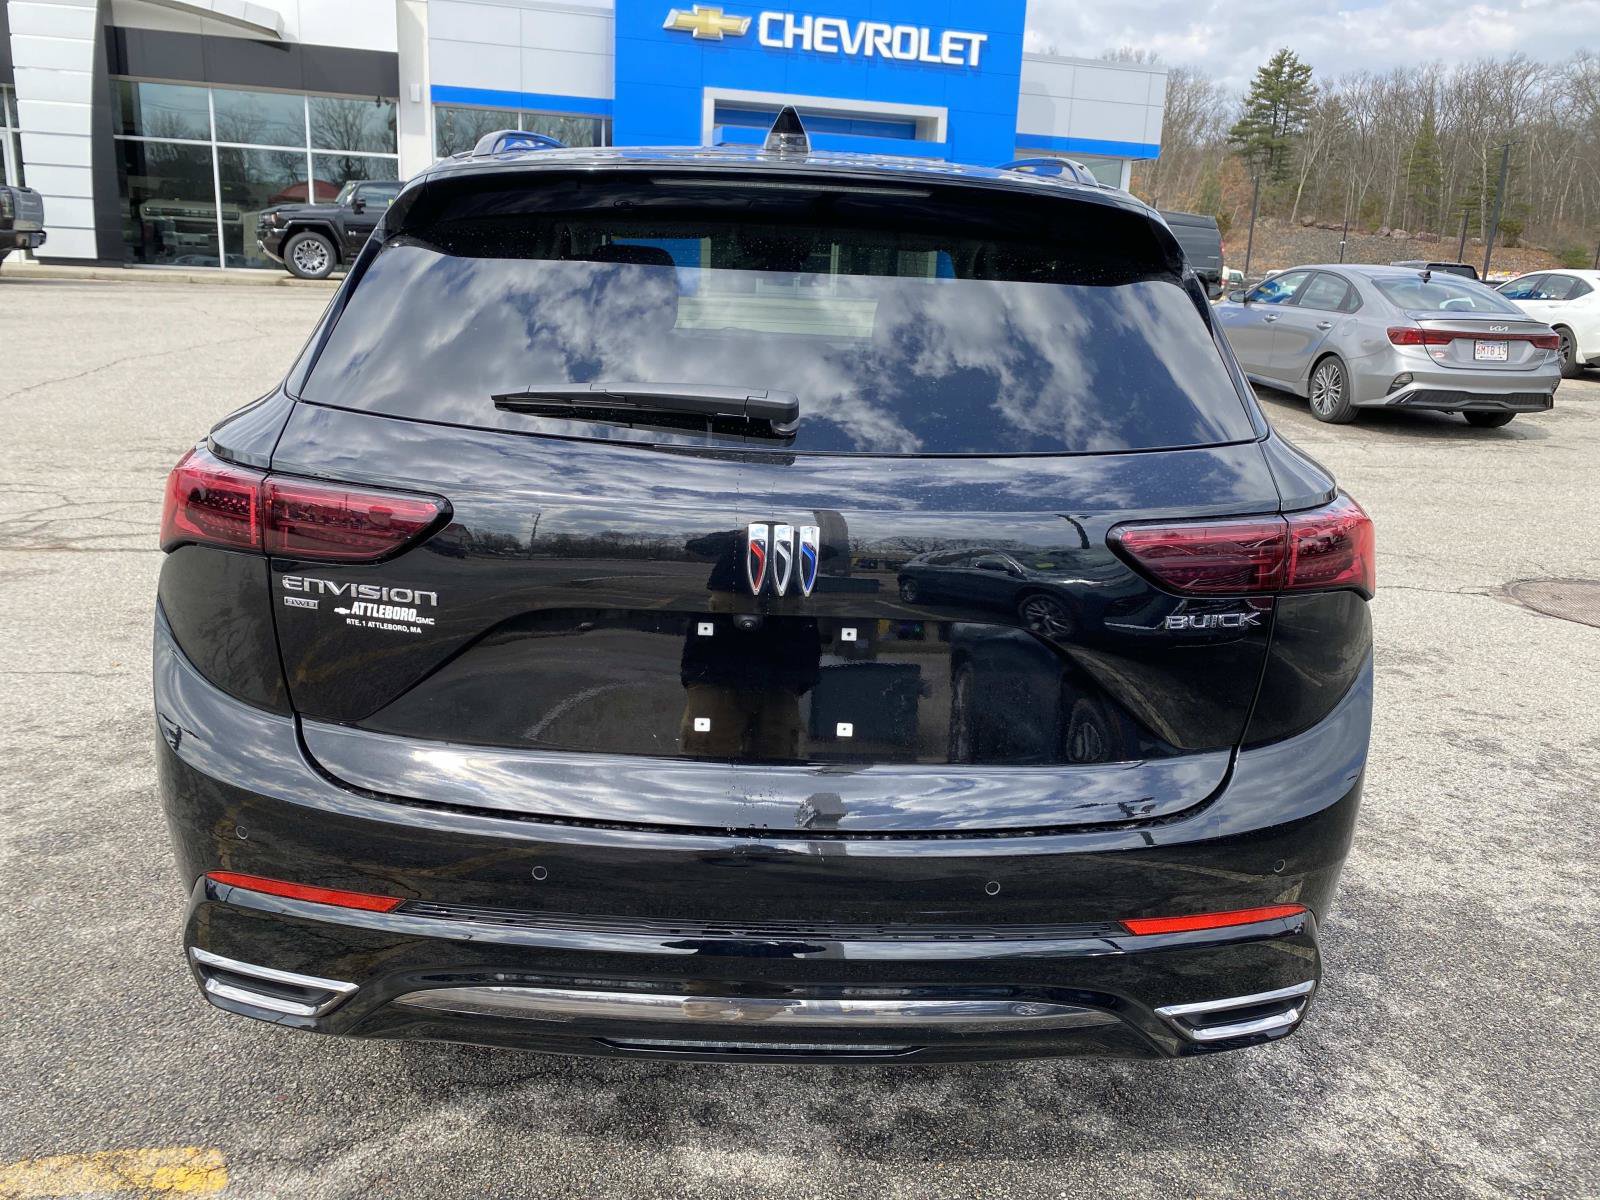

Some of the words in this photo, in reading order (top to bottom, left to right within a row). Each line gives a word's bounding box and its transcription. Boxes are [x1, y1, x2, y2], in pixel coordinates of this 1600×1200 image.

[758, 11, 988, 66] CHEVROLET
[282, 575, 438, 606] ENVISION
[351, 601, 417, 622] ATTLEBORO
[416, 616, 435, 625] GMC
[1165, 612, 1261, 629] BUICK
[346, 618, 361, 627] RTE.
[367, 621, 409, 633] ATTLEBORO,
[410, 626, 422, 634] MA
